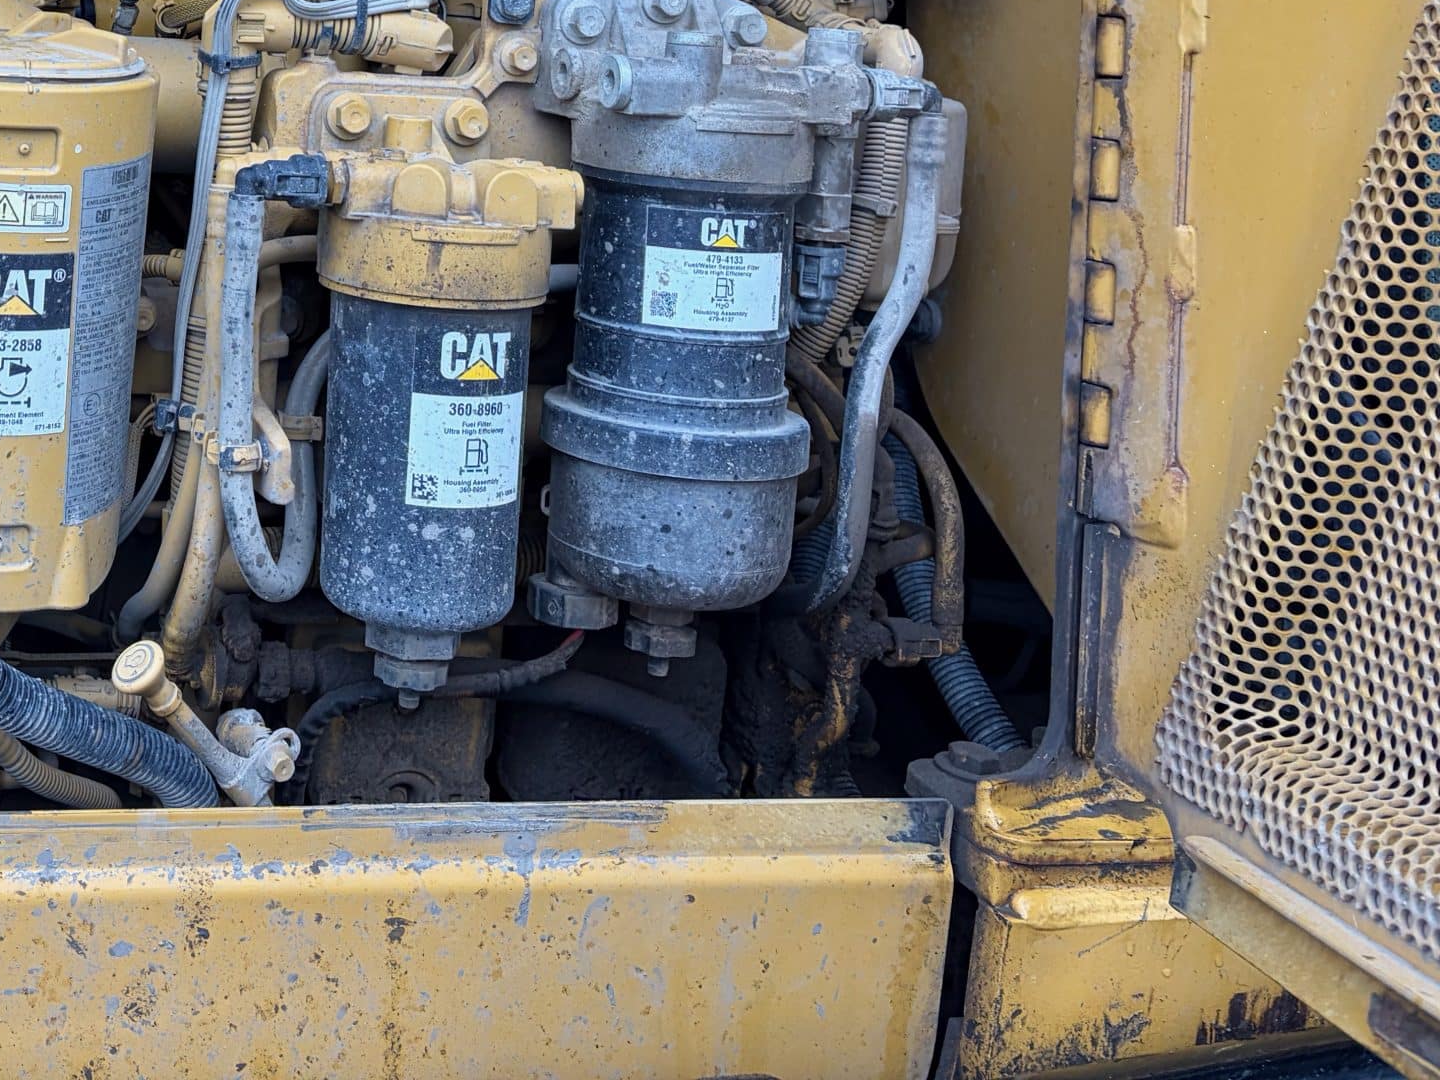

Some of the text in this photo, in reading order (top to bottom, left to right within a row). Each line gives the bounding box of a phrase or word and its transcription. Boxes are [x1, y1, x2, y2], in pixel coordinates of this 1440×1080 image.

[95, 208, 112, 223] CAT
[701, 217, 748, 248] CAT
[706, 254, 743, 265] 479-4133
[725, 270, 752, 278] Efficiency
[441, 331, 512, 380] CAT
[448, 401, 503, 417] 360-8960
[462, 428, 477, 436] High
[478, 427, 504, 435] Efficiency
[473, 478, 499, 486] Assembly
